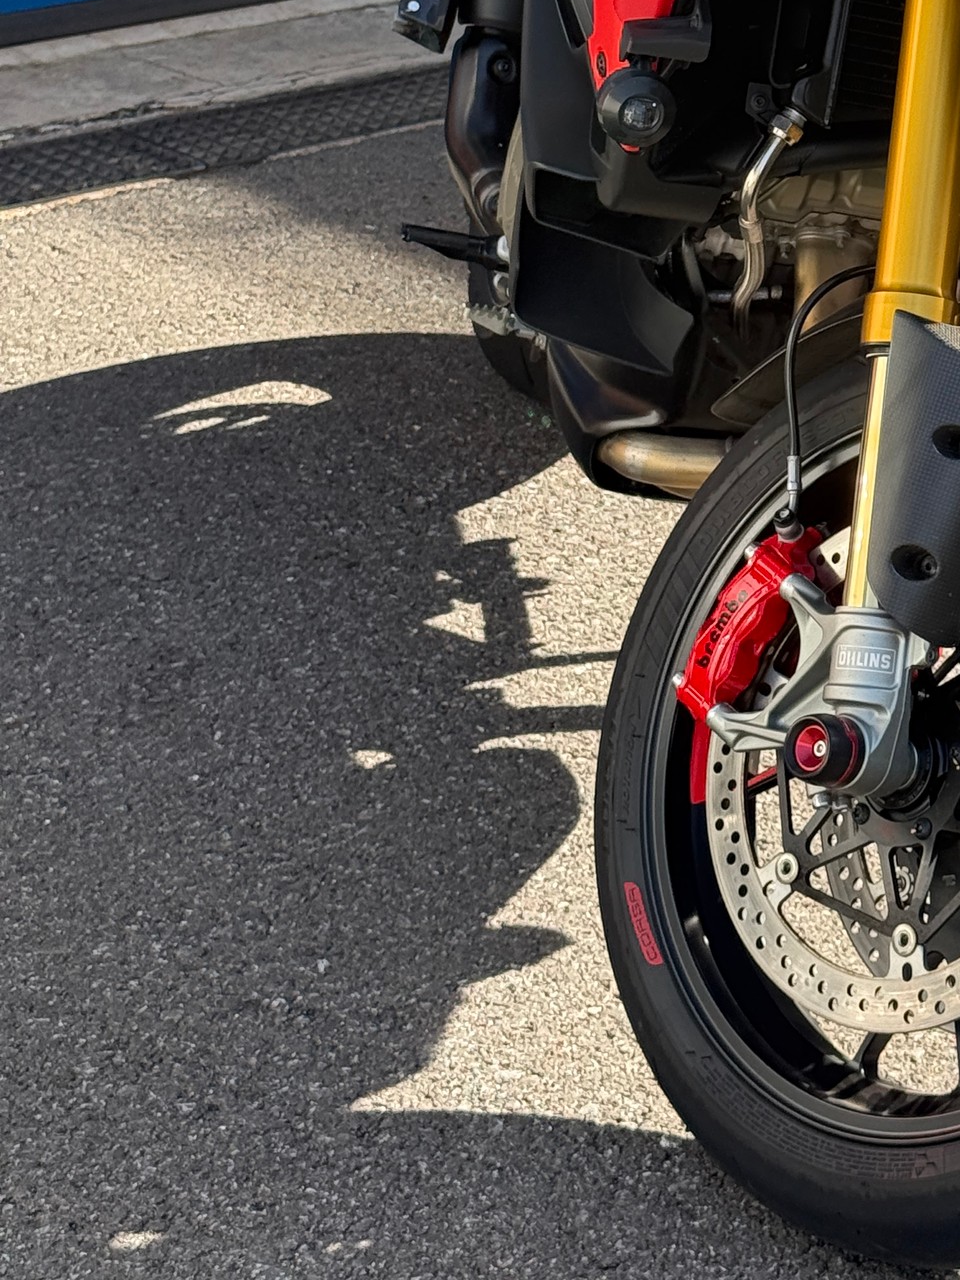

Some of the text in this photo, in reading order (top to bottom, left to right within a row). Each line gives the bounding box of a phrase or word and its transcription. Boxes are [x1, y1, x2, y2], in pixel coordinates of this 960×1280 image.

[696, 588, 749, 668] brembo
[838, 646, 892, 670] ÖHLINS
[627, 886, 658, 961] CORSA
